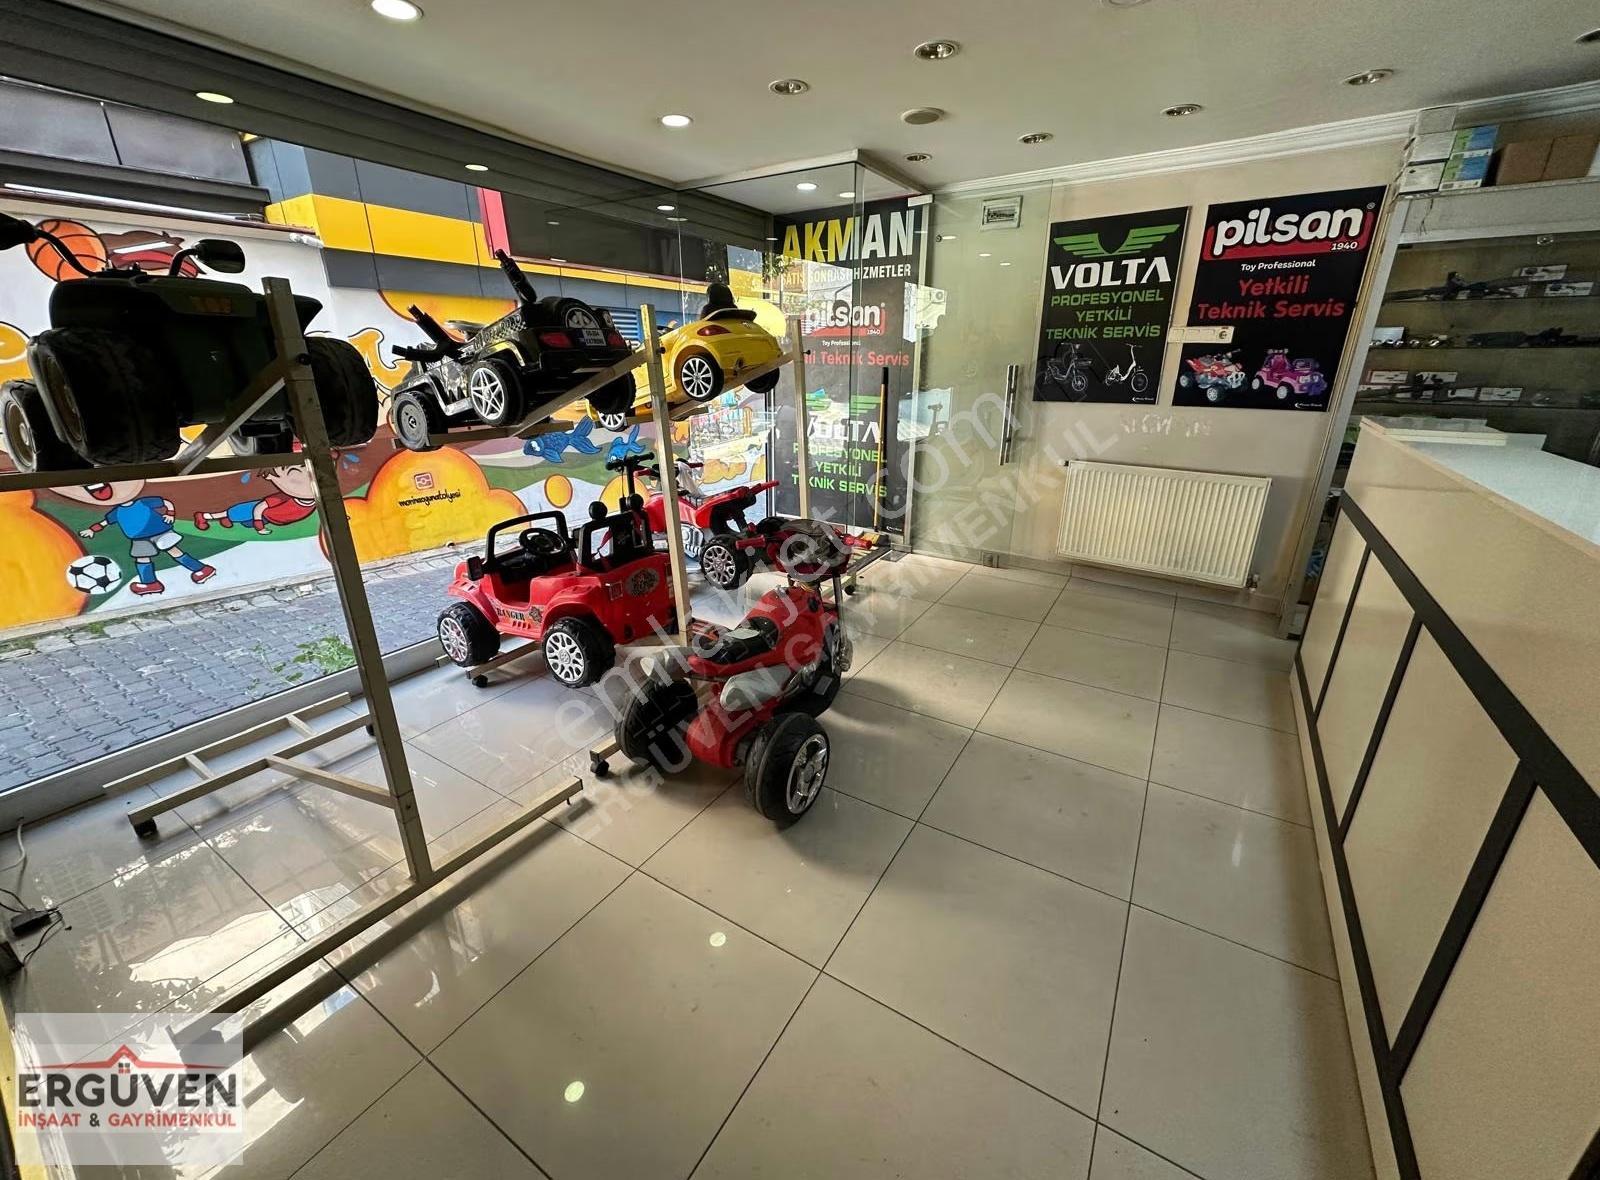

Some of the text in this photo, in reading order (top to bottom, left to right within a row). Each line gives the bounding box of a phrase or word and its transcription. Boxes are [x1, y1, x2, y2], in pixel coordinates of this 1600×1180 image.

[783, 209, 915, 263] AKMAN
[1212, 207, 1366, 257] pilsan
[1330, 241, 1359, 252] 1940
[1050, 257, 1172, 290] VOLTA
[1240, 258, 1317, 273] Toy Professional
[1239, 274, 1310, 297] Yetkili
[1051, 289, 1165, 308] PROFESYONEL
[1075, 306, 1132, 323] YETKİLİ
[1198, 297, 1345, 320] Teknik Servis
[1046, 322, 1161, 341] TEKNİK SERVİS
[820, 350, 863, 365] Teknik
[867, 351, 910, 366] Servis
[793, 442, 888, 463] POFESYONEL
[791, 473, 835, 491] TKNİK
